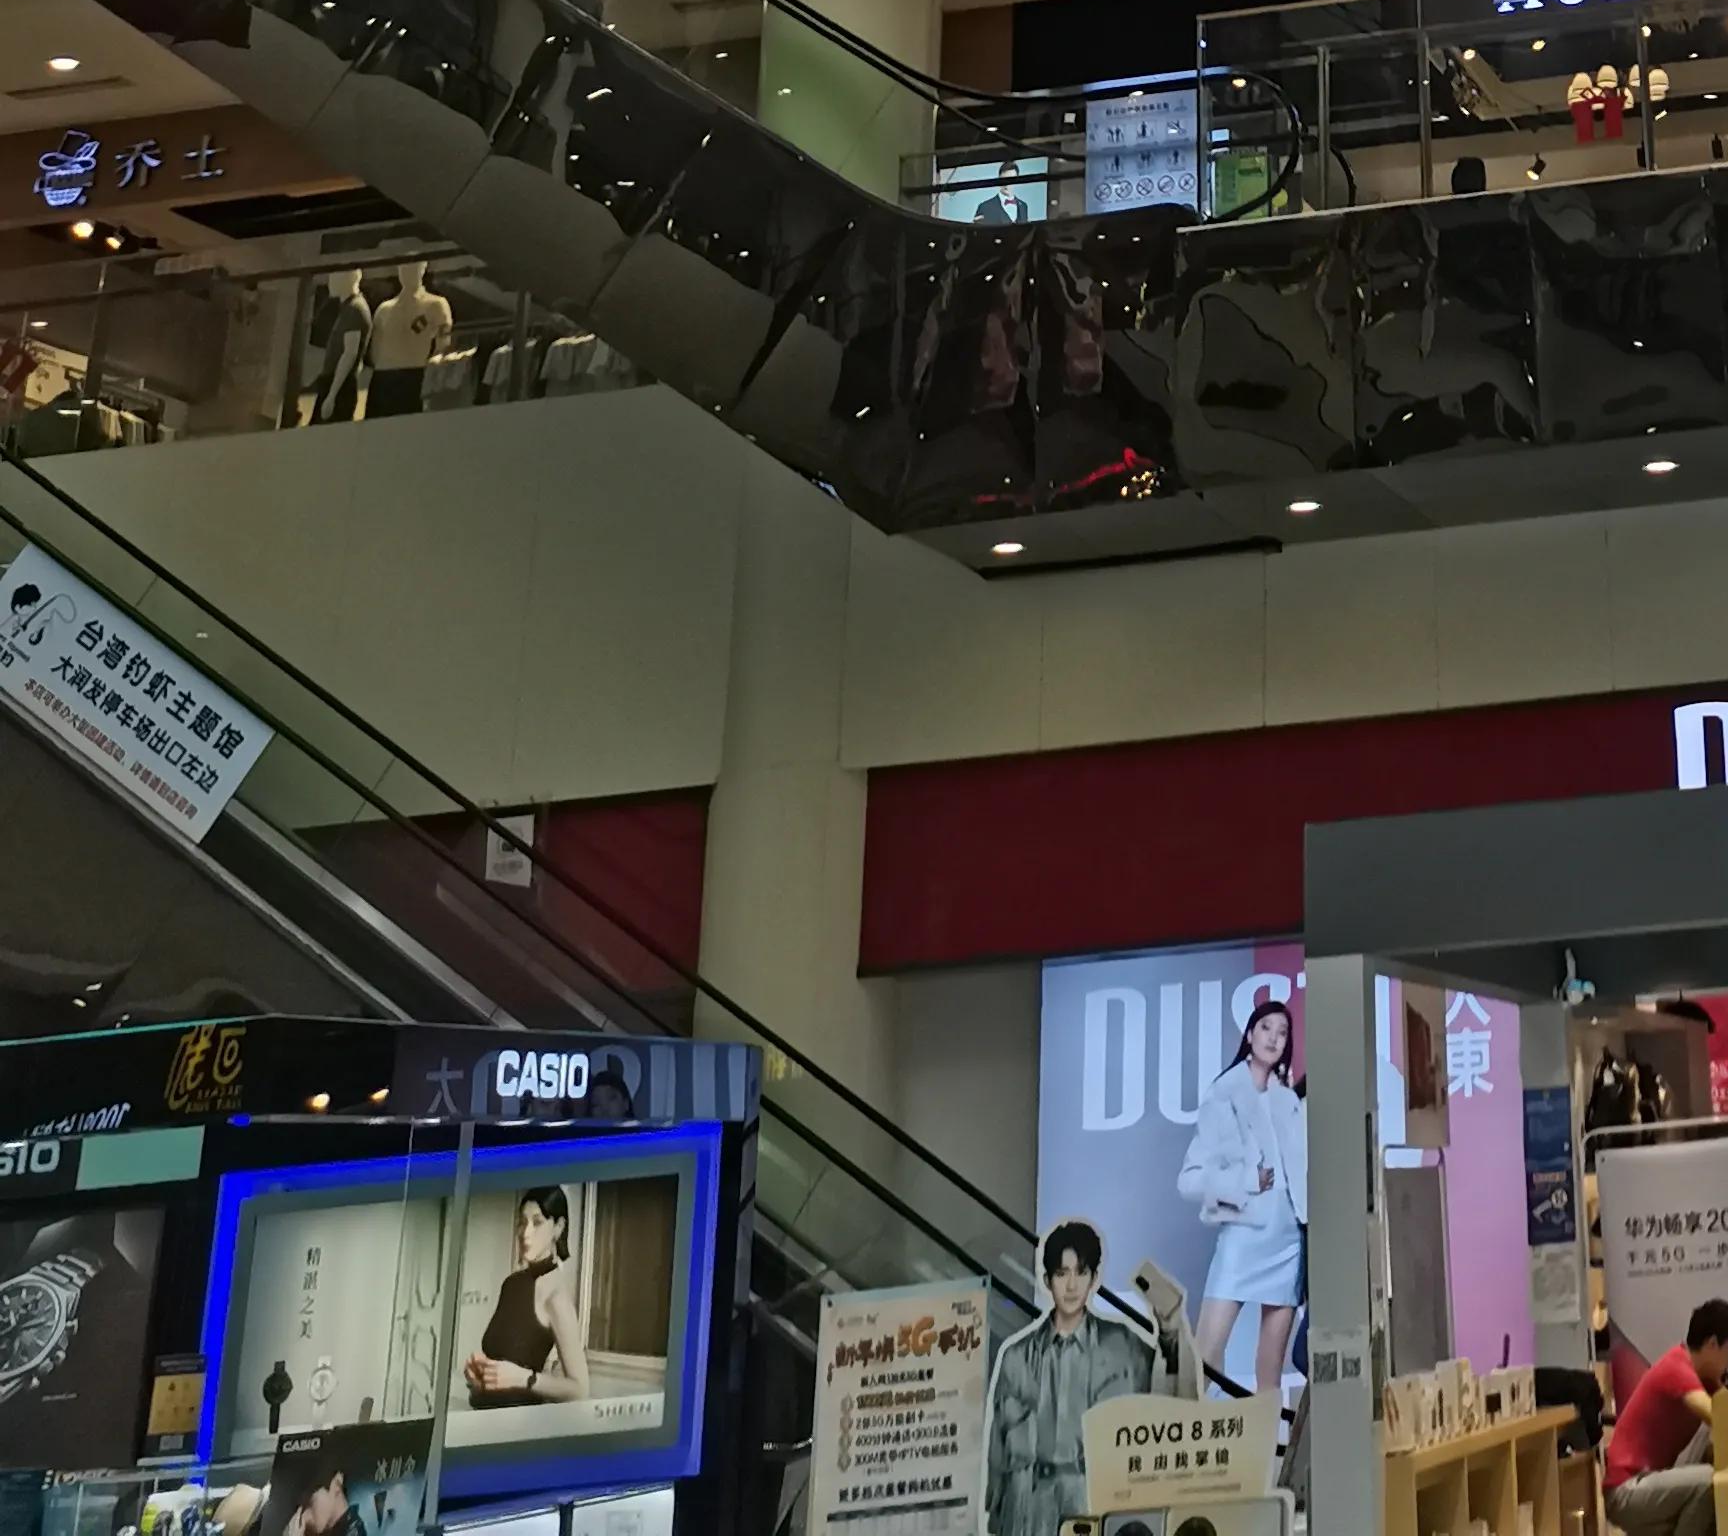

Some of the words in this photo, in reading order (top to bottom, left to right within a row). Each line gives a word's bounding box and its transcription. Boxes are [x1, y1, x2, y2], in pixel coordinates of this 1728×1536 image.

[50, 654, 221, 795] 大润发停车场出口左边
[75, 618, 246, 760] 台湾钓虾主题馆
[495, 1048, 590, 1100] CASIO
[1082, 971, 1306, 1132] DUS
[282, 1437, 321, 1453] CASIO
[1115, 1421, 1184, 1447] nova
[1190, 1420, 1204, 1442] 8
[1209, 1415, 1245, 1440] 系列
